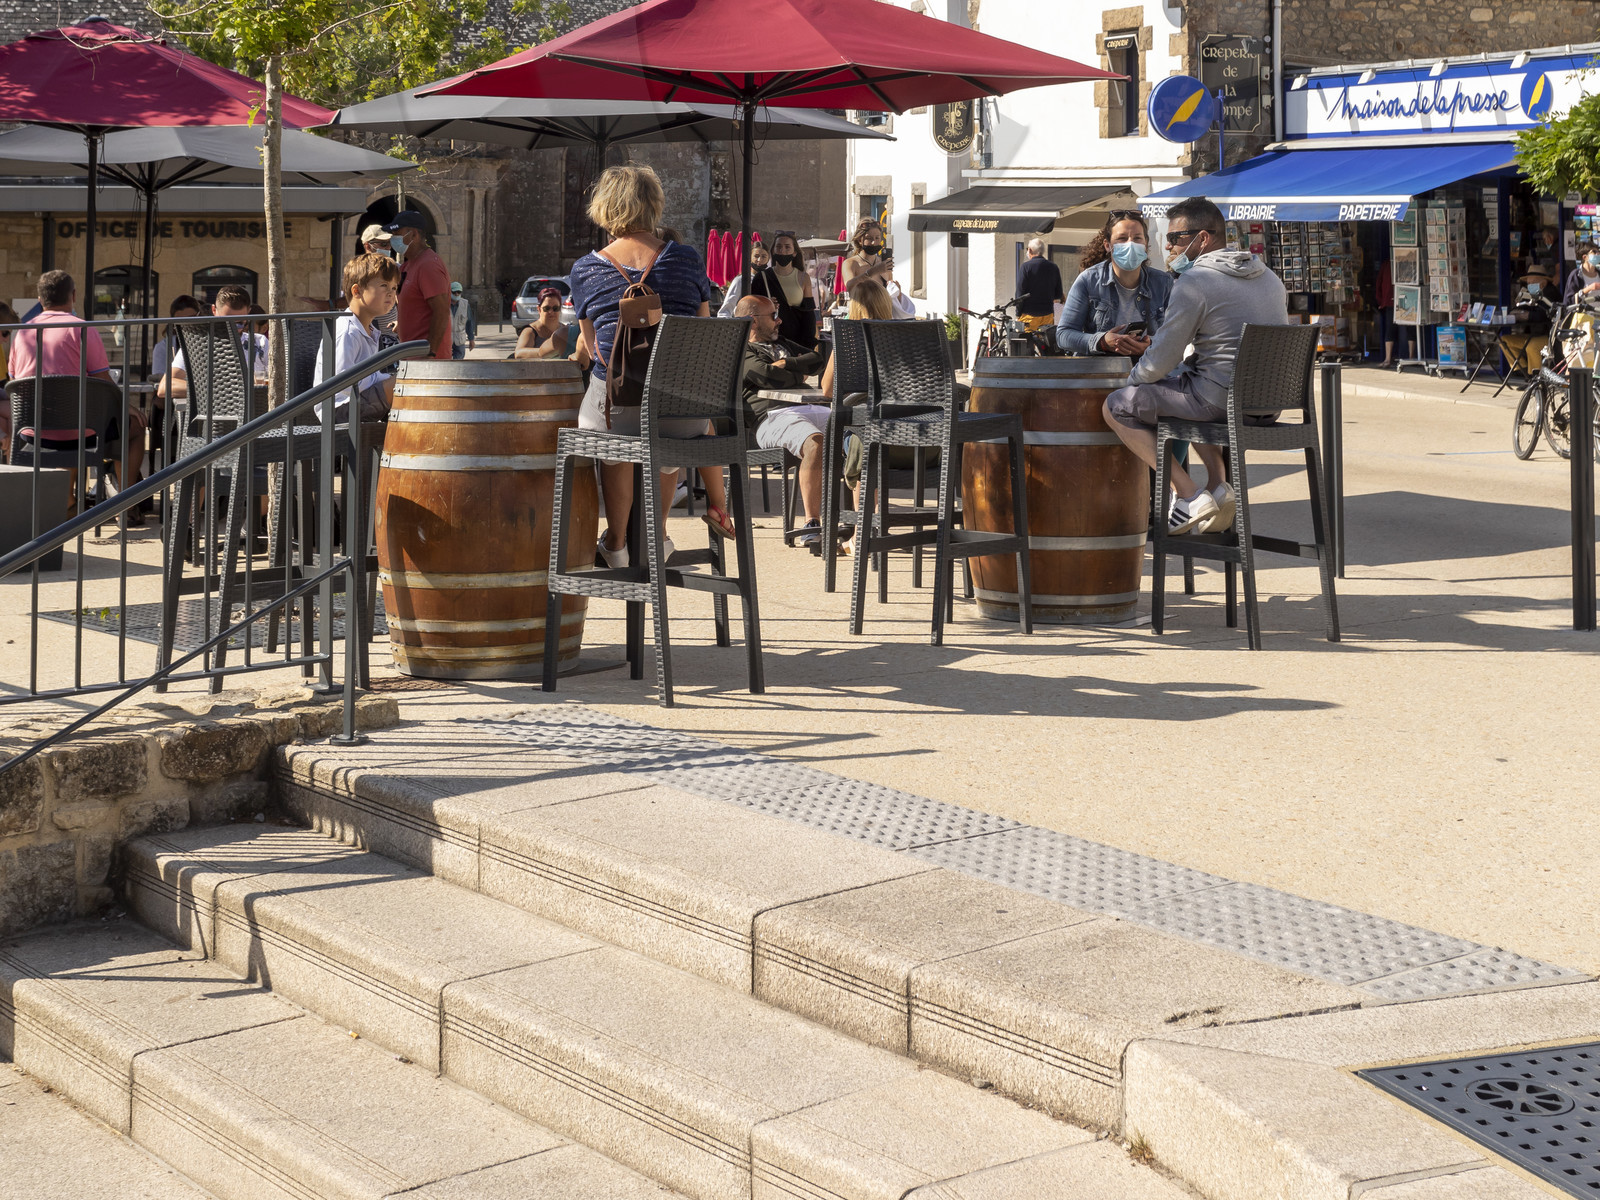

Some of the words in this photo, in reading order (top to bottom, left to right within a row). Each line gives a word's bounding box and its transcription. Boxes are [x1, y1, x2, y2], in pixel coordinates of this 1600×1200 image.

[1141, 204, 1176, 218] PRESS
[1228, 205, 1276, 220] LIBRAIRIE
[1338, 204, 1402, 221] PAPETERIE
[179, 221, 292, 238] TOURISE
